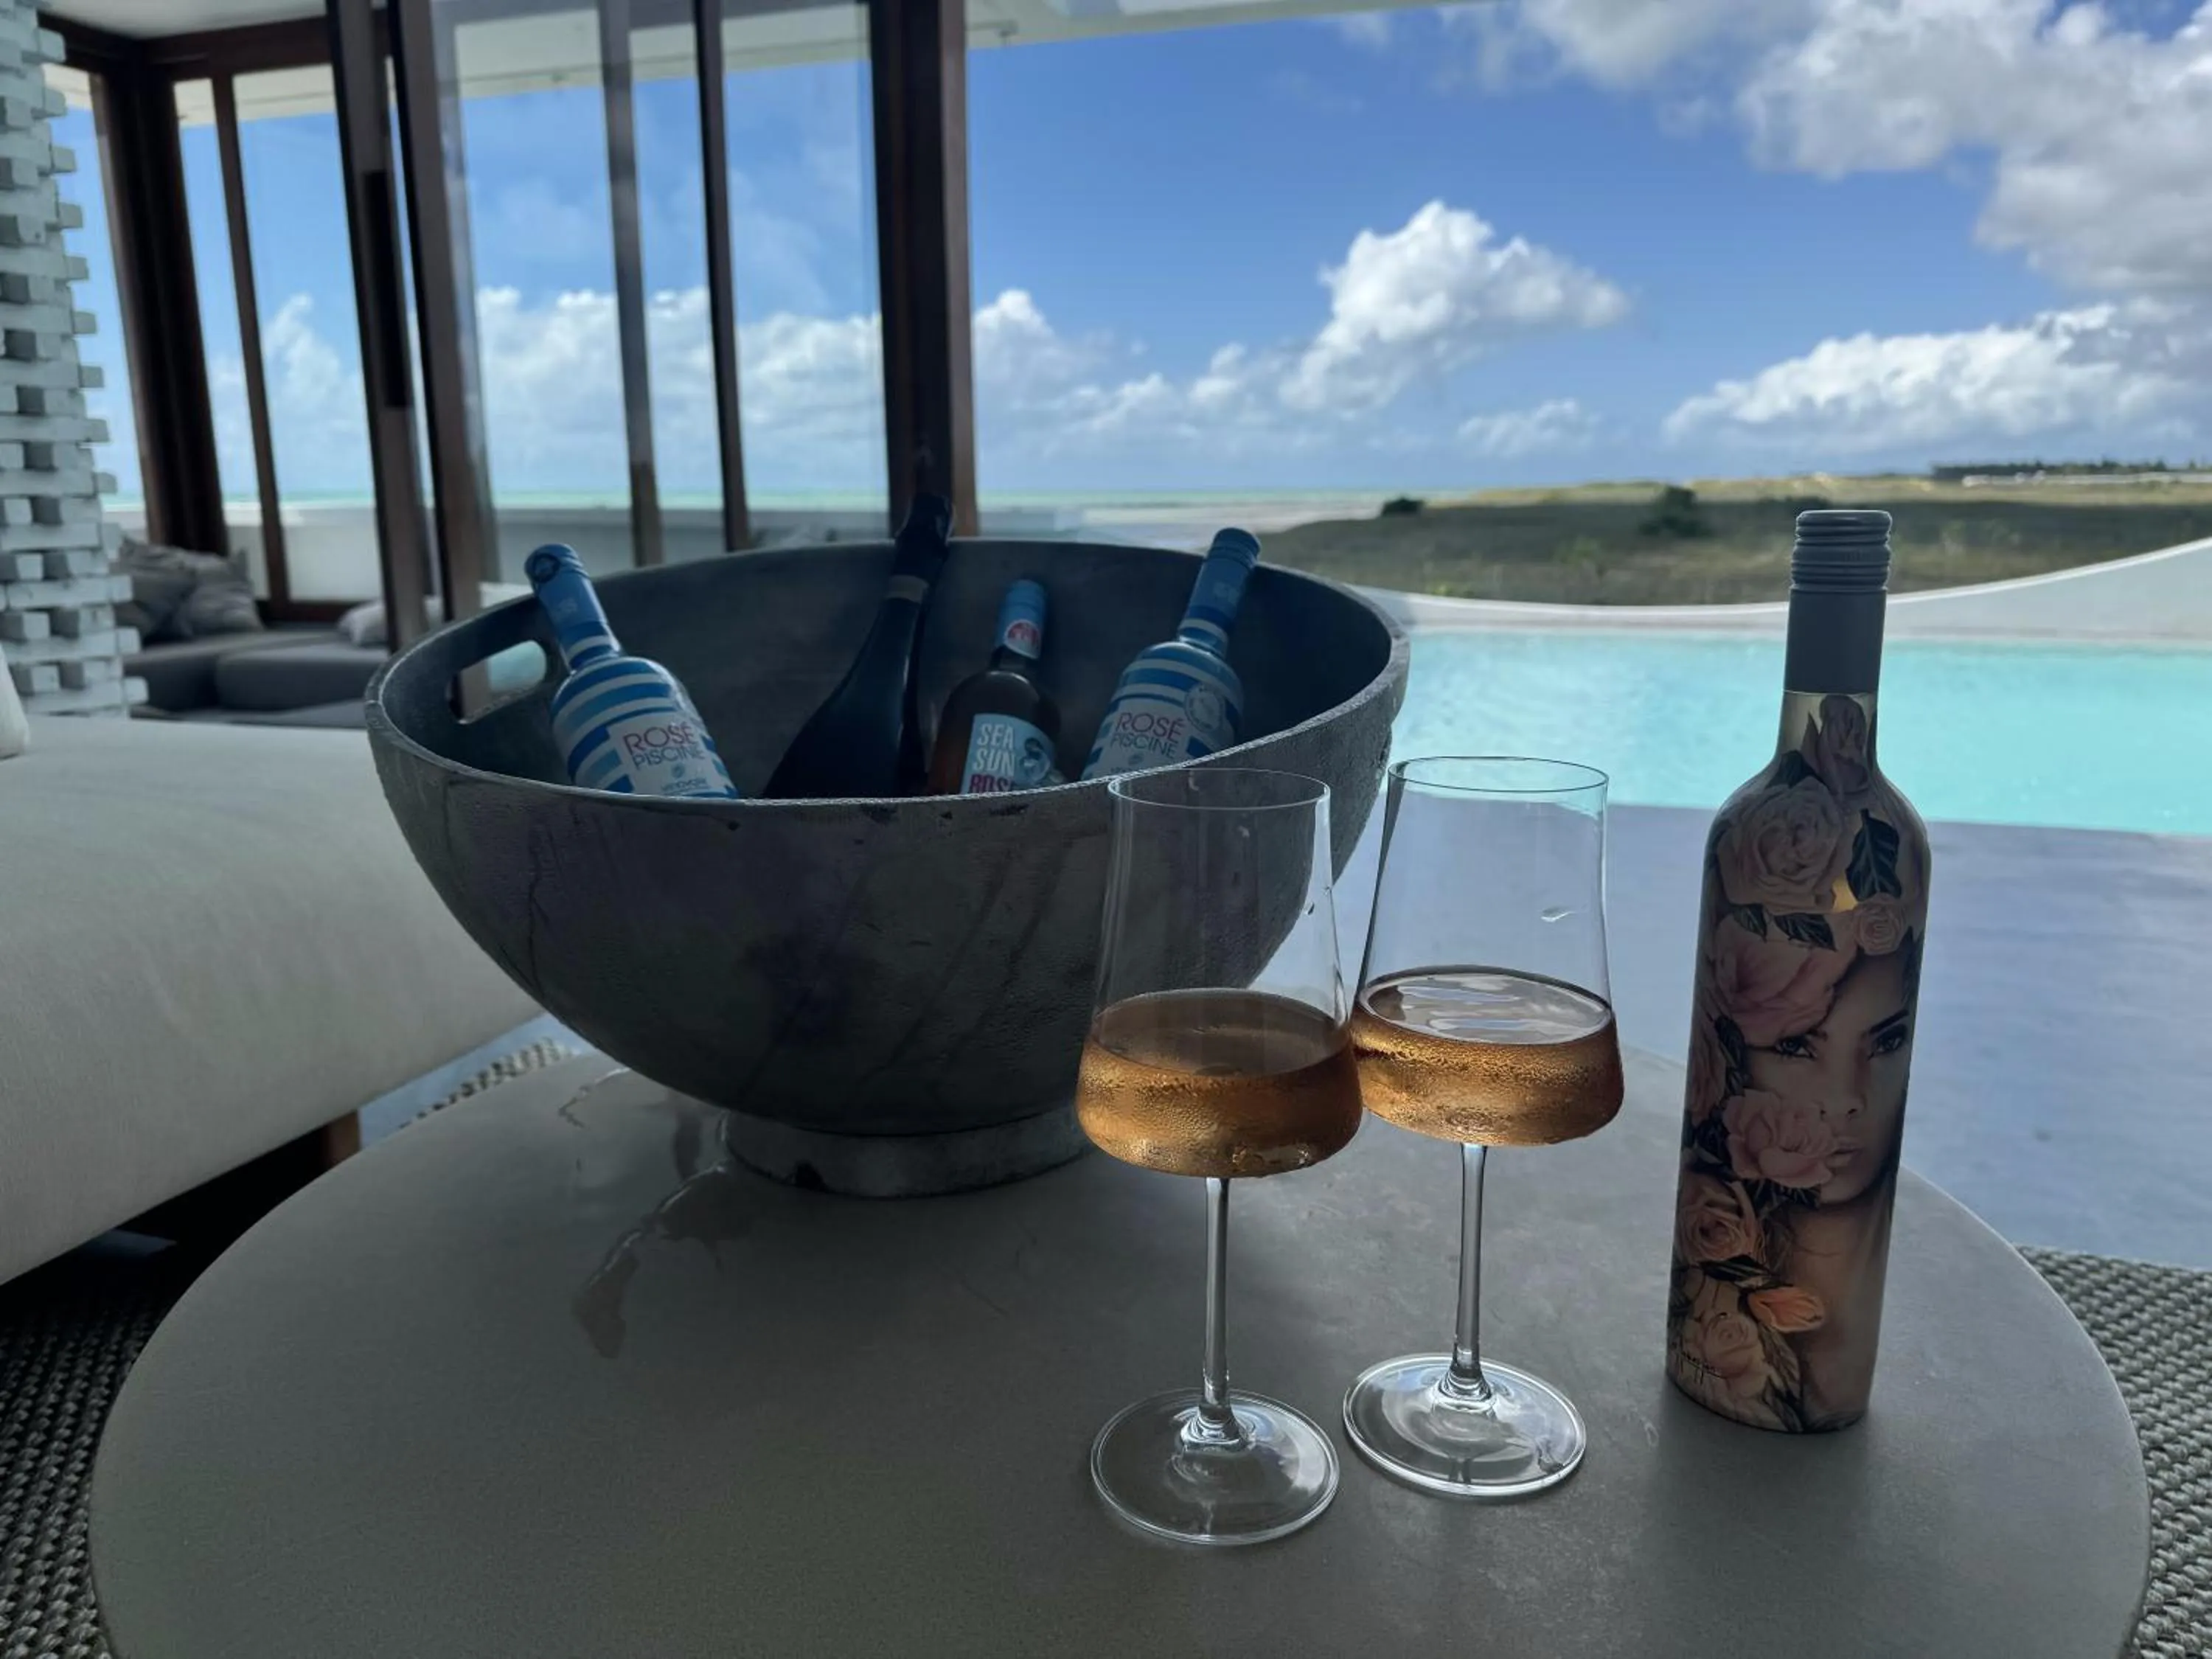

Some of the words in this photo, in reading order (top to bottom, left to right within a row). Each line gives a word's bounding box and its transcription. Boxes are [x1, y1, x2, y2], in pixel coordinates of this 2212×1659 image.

[977, 723, 1014, 749] SEA
[1110, 732, 1177, 759] PISCINE
[632, 743, 705, 771] PISCINE
[973, 748, 1015, 774] SUN
